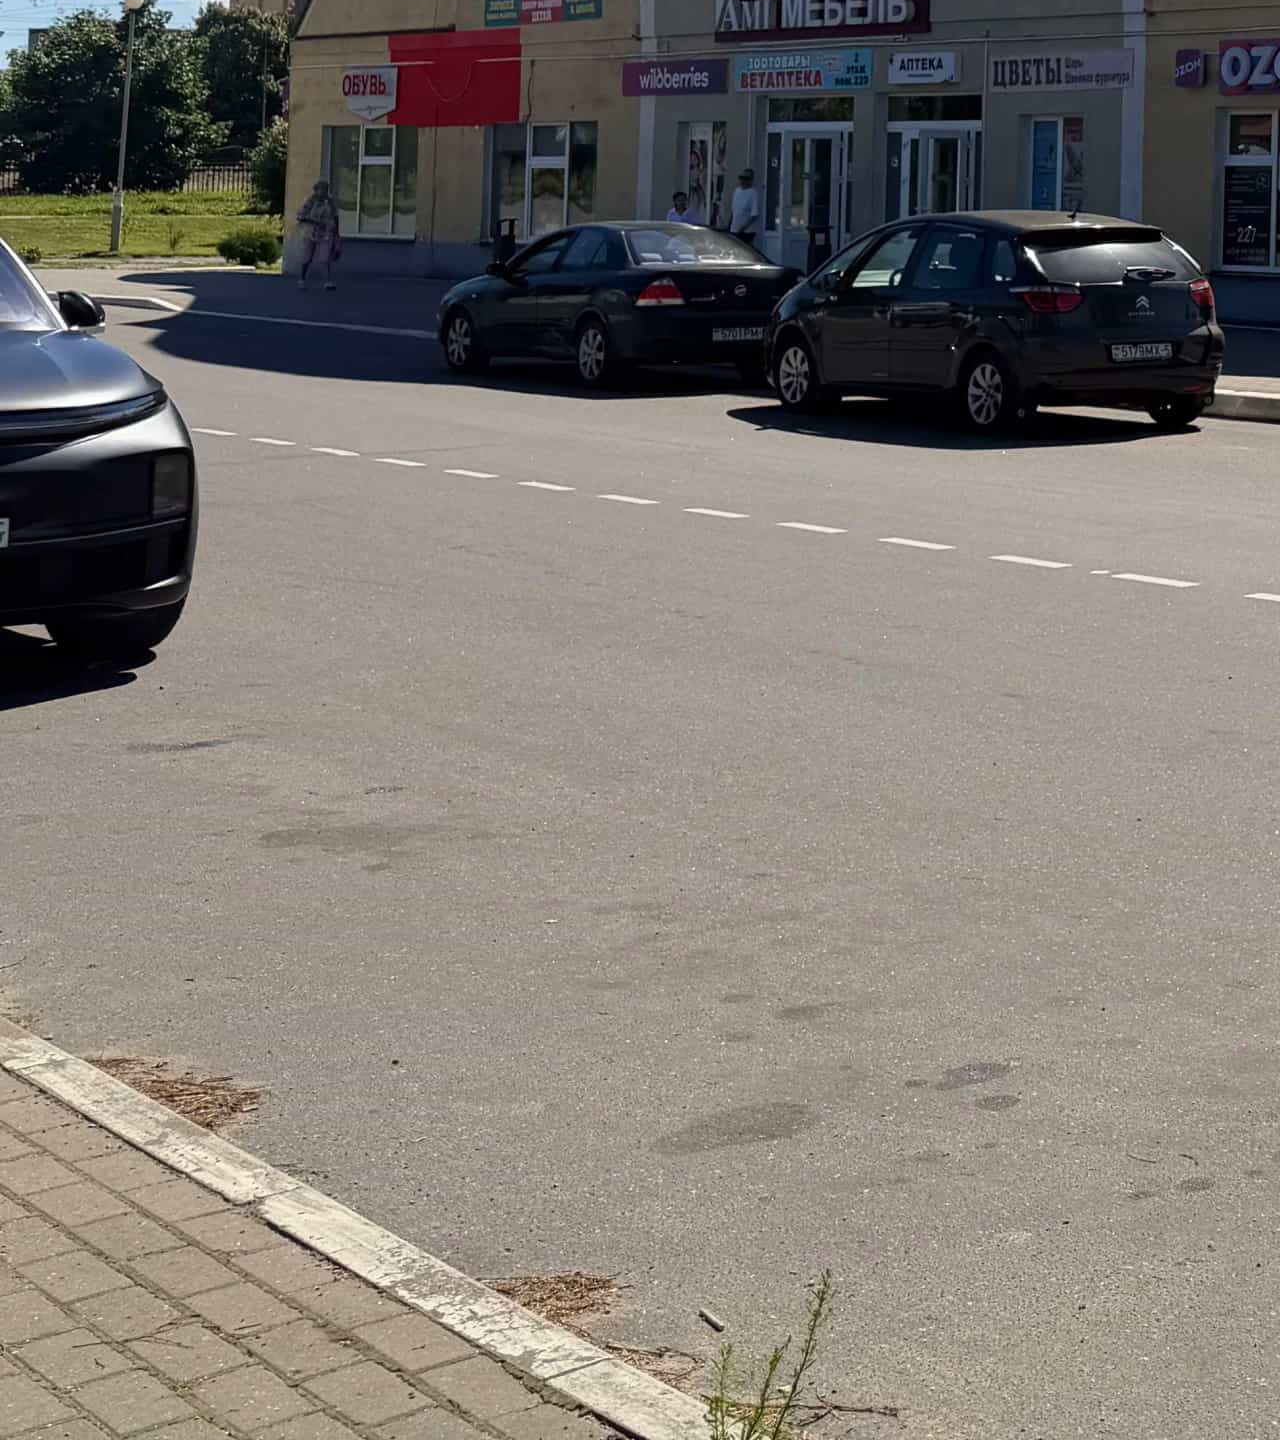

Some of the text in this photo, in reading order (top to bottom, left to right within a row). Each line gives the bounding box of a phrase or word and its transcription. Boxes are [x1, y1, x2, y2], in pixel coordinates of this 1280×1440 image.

[748, 55, 810, 70] ЗООТОВАРЫ
[899, 57, 944, 72] АПТЕКА
[993, 58, 1062, 87] ЦВЕТЫ
[342, 73, 387, 97] ОБУВЬ
[639, 66, 710, 90] wildberries
[740, 70, 823, 88] ВЕТАПТЕКА
